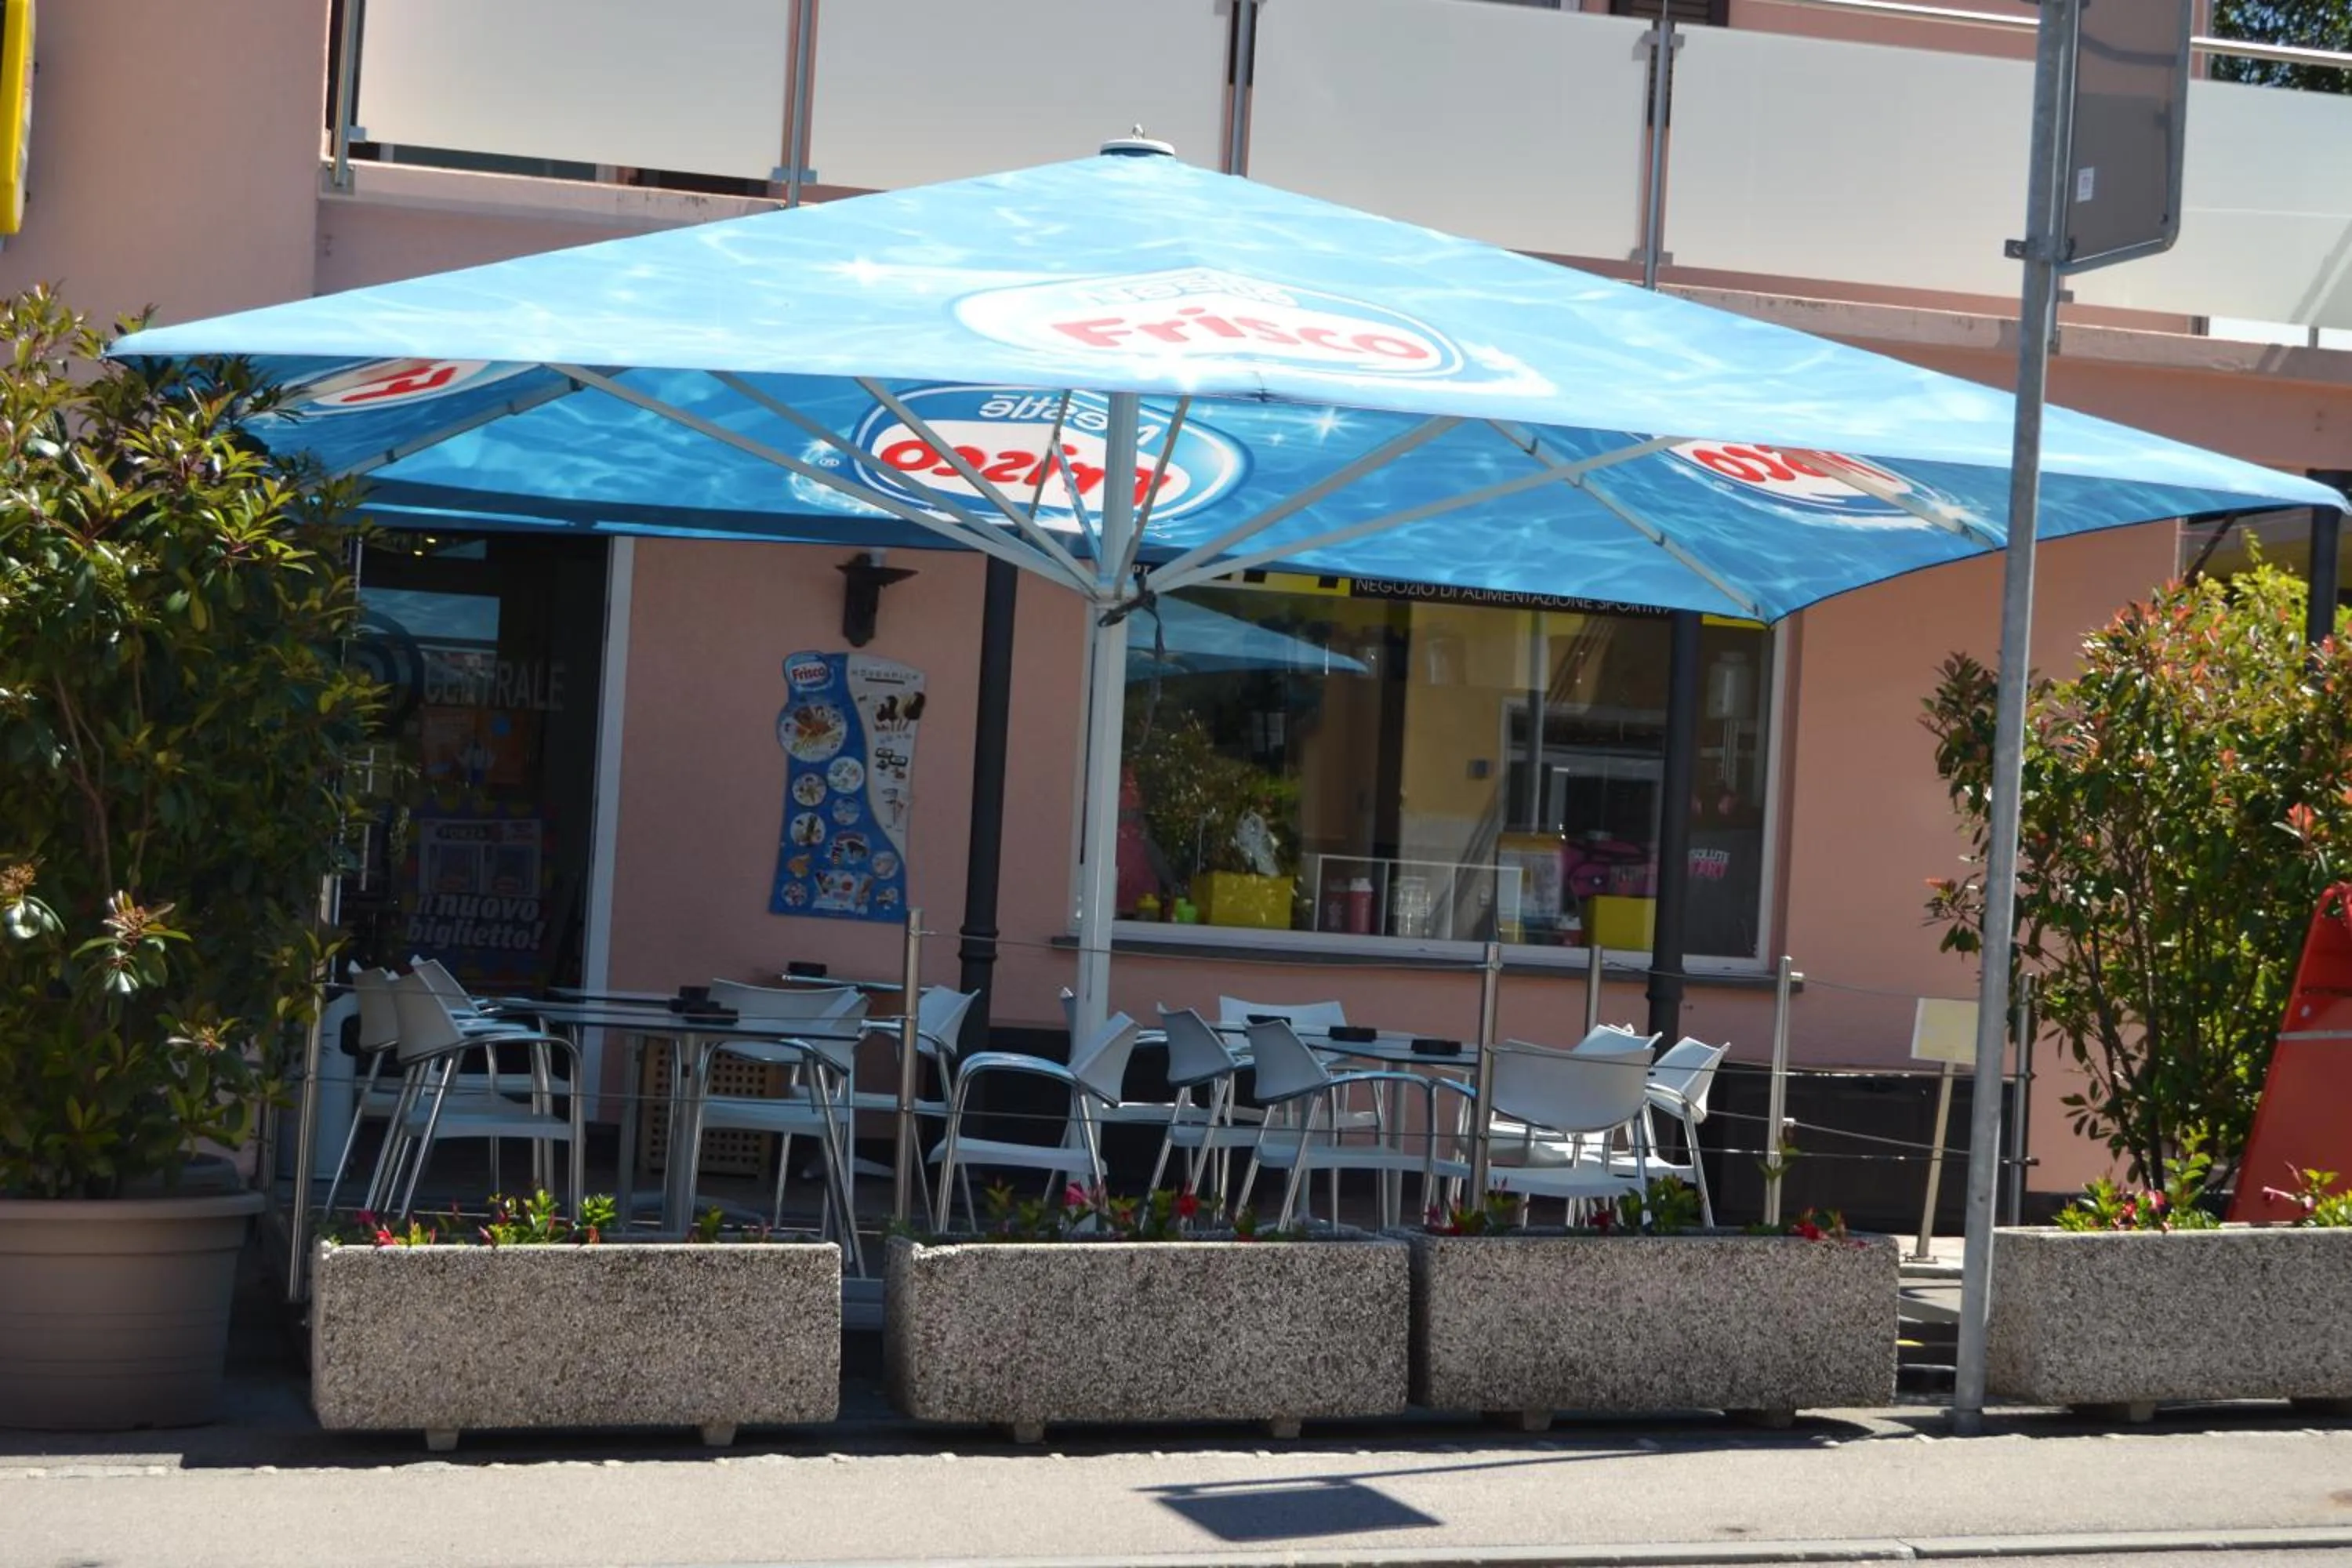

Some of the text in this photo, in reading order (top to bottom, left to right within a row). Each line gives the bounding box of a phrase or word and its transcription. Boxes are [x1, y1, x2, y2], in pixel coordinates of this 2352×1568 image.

[1051, 307, 1430, 361] Frisco
[1355, 578, 1436, 597] NEGOZIO
[1462, 586, 1592, 610] ALIMENTAZIONE
[423, 657, 566, 711] CENTRALE
[790, 666, 826, 682] Frisco
[436, 893, 539, 922] nuovo
[404, 915, 545, 951] biglietto!
